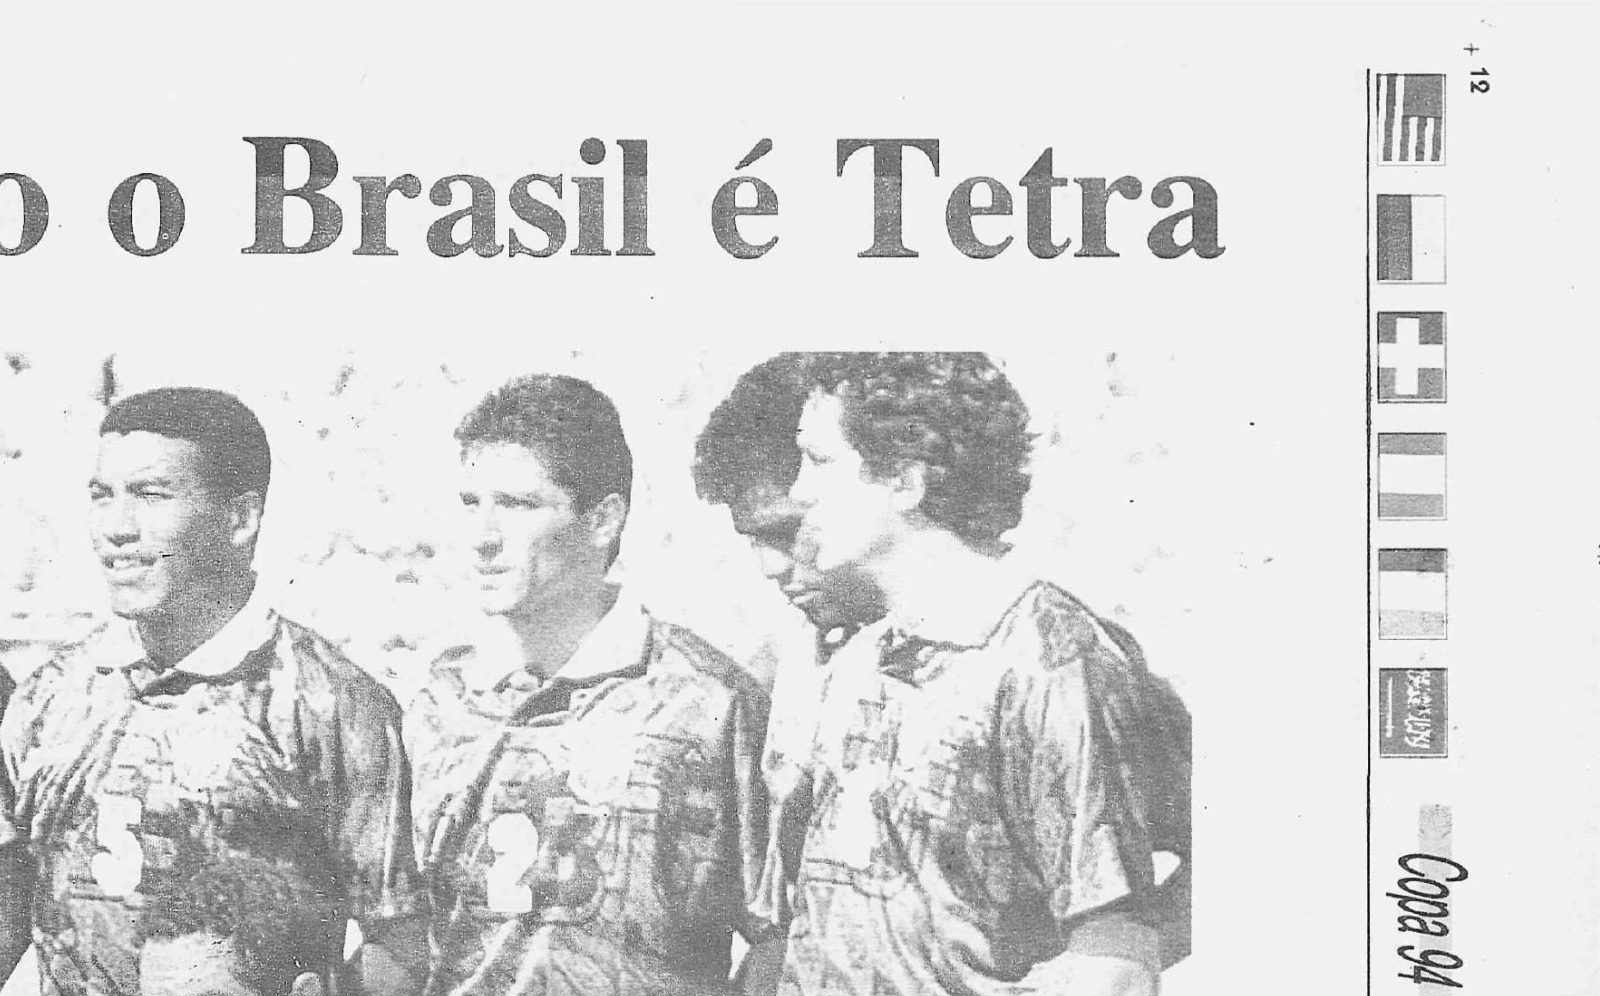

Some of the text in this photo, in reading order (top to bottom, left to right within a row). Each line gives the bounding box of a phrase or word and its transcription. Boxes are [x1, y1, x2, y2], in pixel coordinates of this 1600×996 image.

[1470, 67, 1490, 94] 12
[108, 173, 185, 257] o
[241, 137, 655, 258] Brasil
[712, 139, 778, 259] é
[837, 139, 1225, 259] Tetra
[486, 811, 539, 913] 2
[1385, 853, 1469, 989] Copa 94
